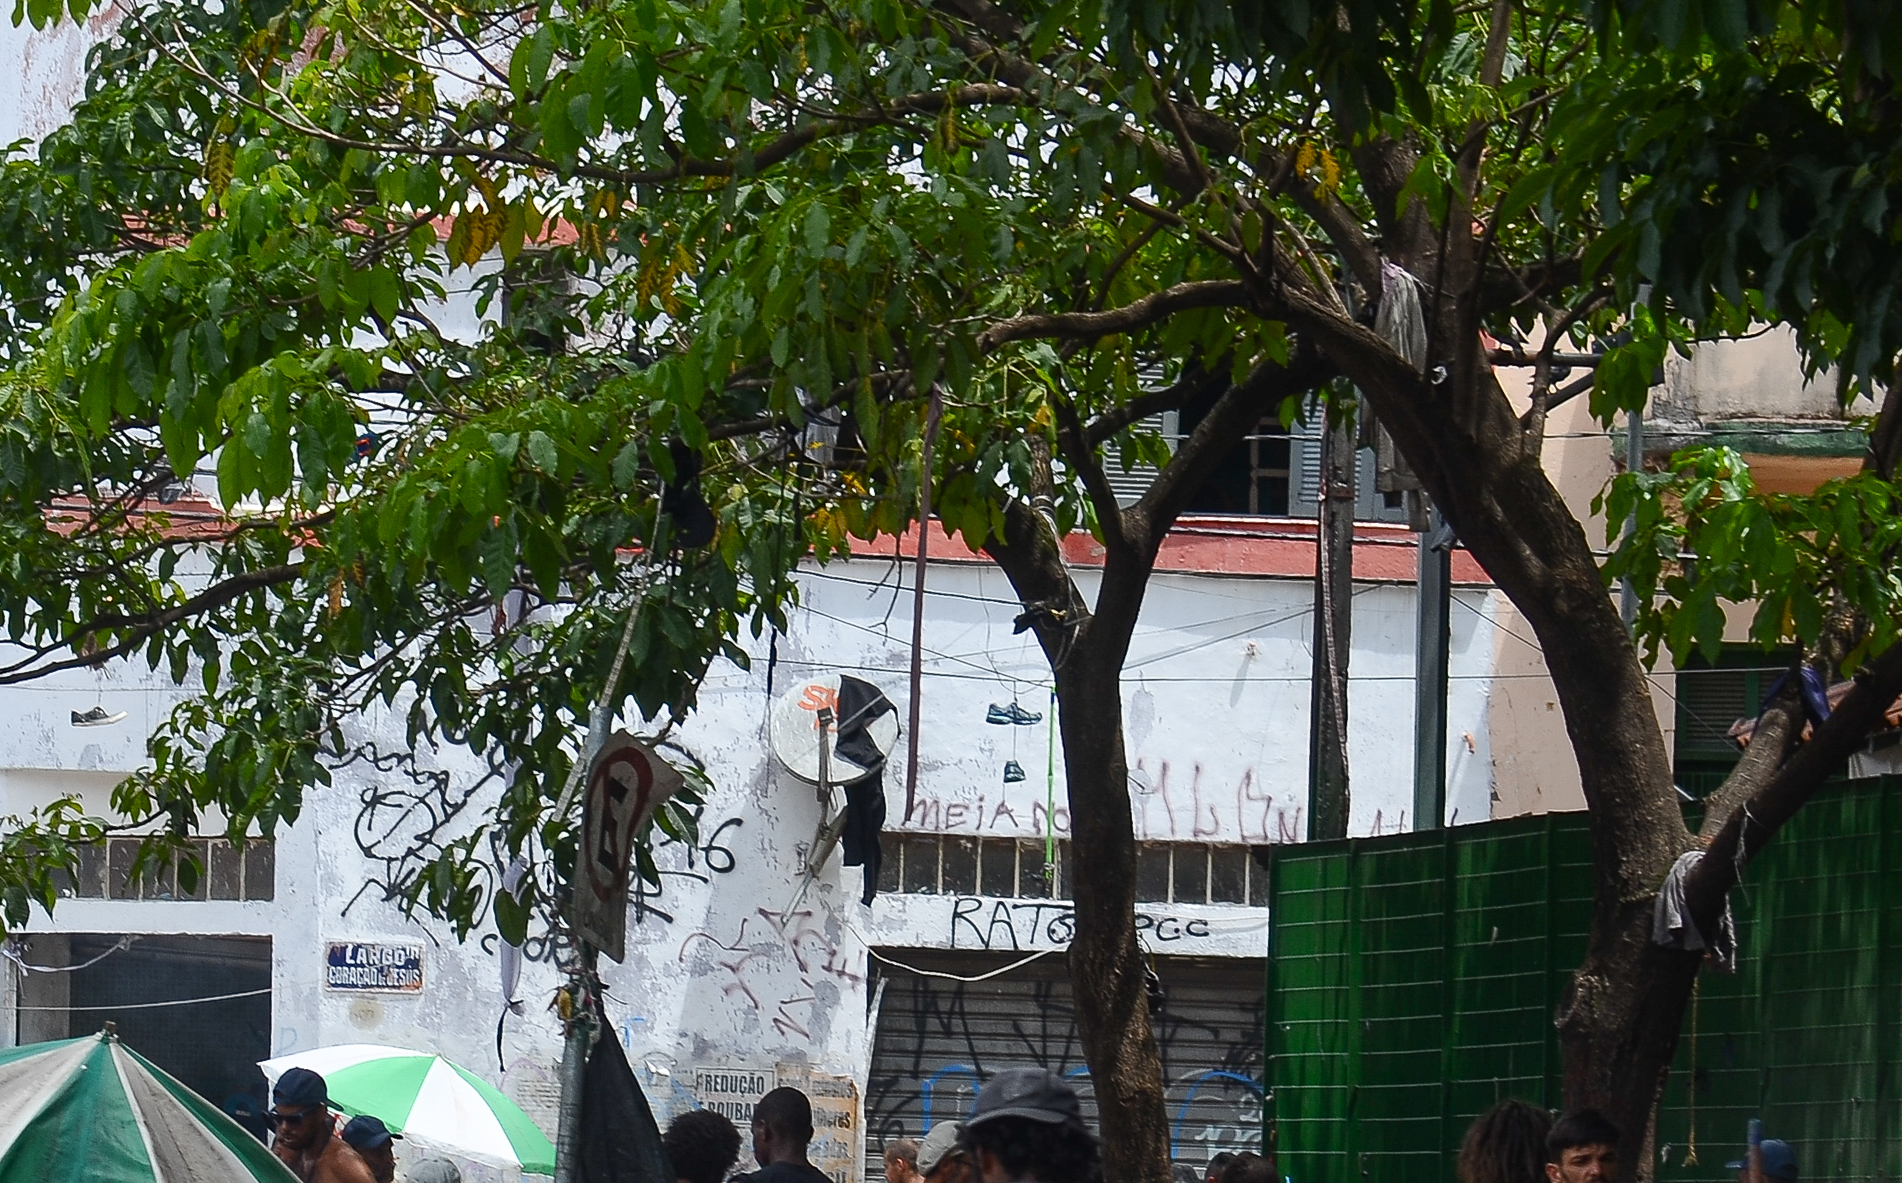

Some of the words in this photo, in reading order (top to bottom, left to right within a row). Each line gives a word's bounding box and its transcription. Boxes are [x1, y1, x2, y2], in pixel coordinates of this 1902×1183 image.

[345, 943, 406, 966] LARGO
[386, 967, 422, 987] JESUS
[704, 1073, 766, 1097] REDUÇÃO
